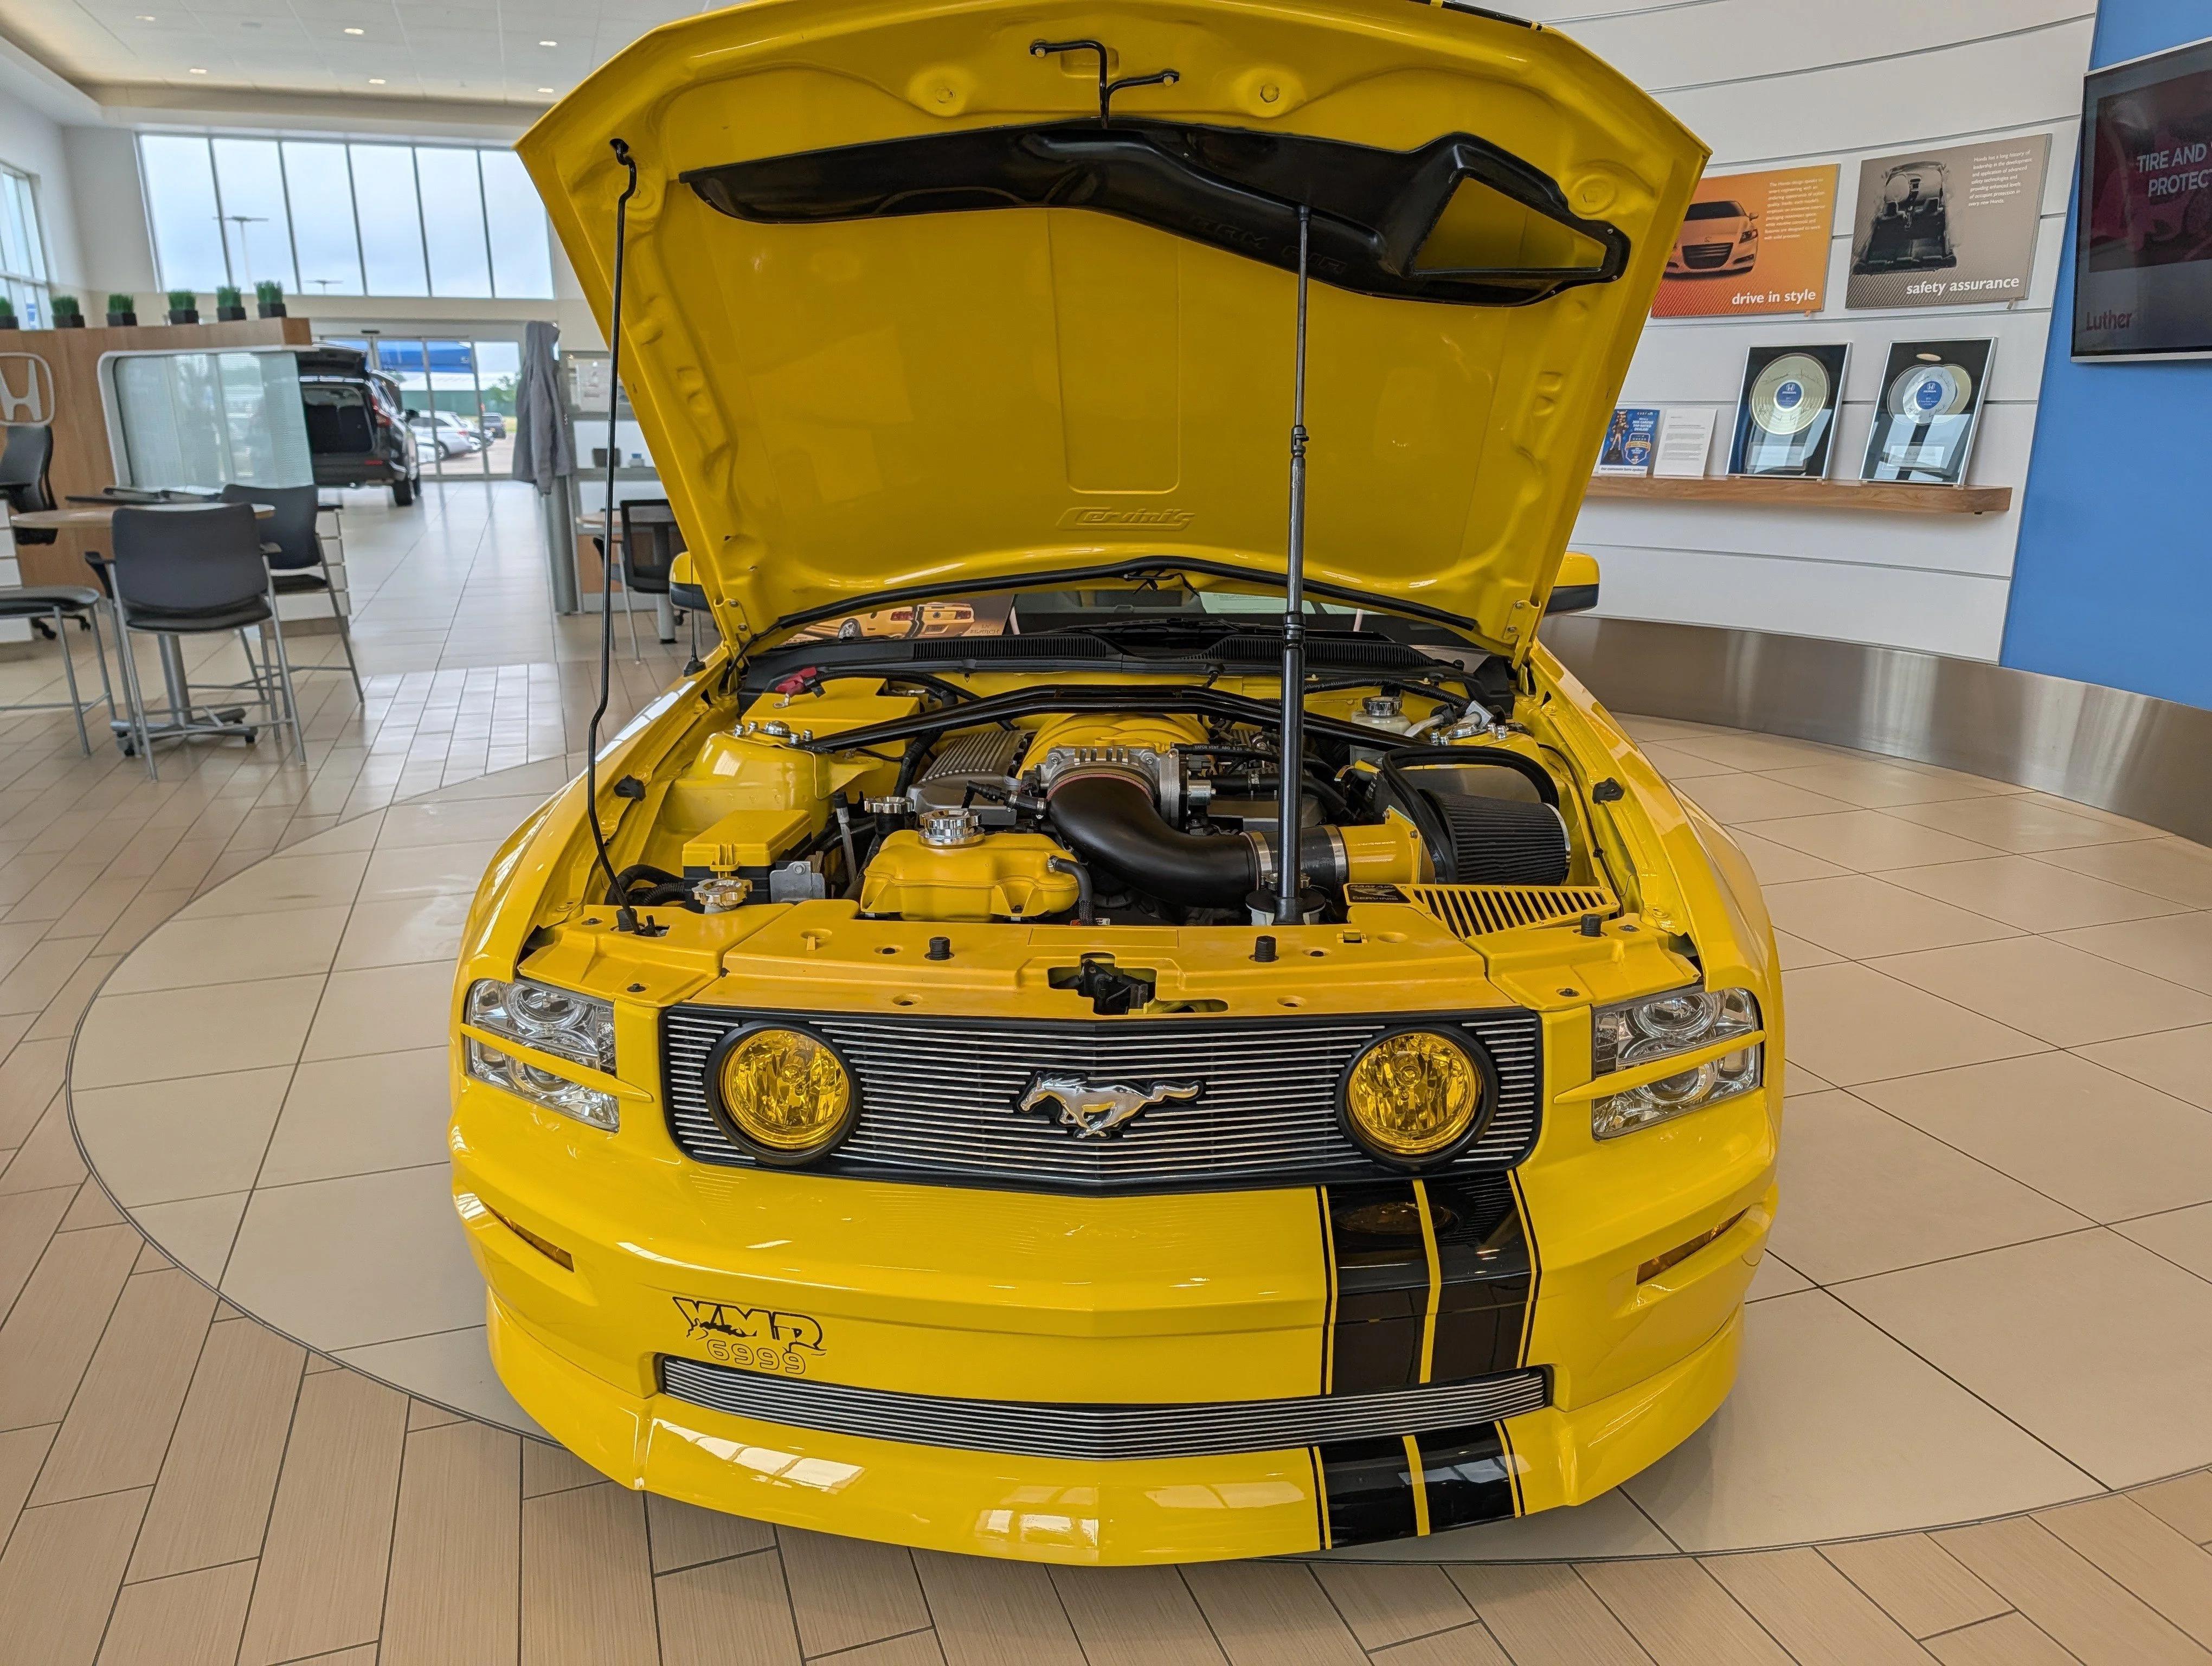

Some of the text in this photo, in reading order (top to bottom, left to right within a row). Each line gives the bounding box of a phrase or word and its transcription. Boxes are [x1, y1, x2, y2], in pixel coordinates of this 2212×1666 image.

[2137, 150, 2169, 173] TIRE
[2171, 143, 2207, 167] AND
[2147, 168, 2212, 197] PROTEC
[1732, 289, 1816, 304] drive in style
[1906, 278, 2019, 296] safety assurance
[2086, 310, 2132, 330] Luther
[707, 1339, 806, 1374] 6999
